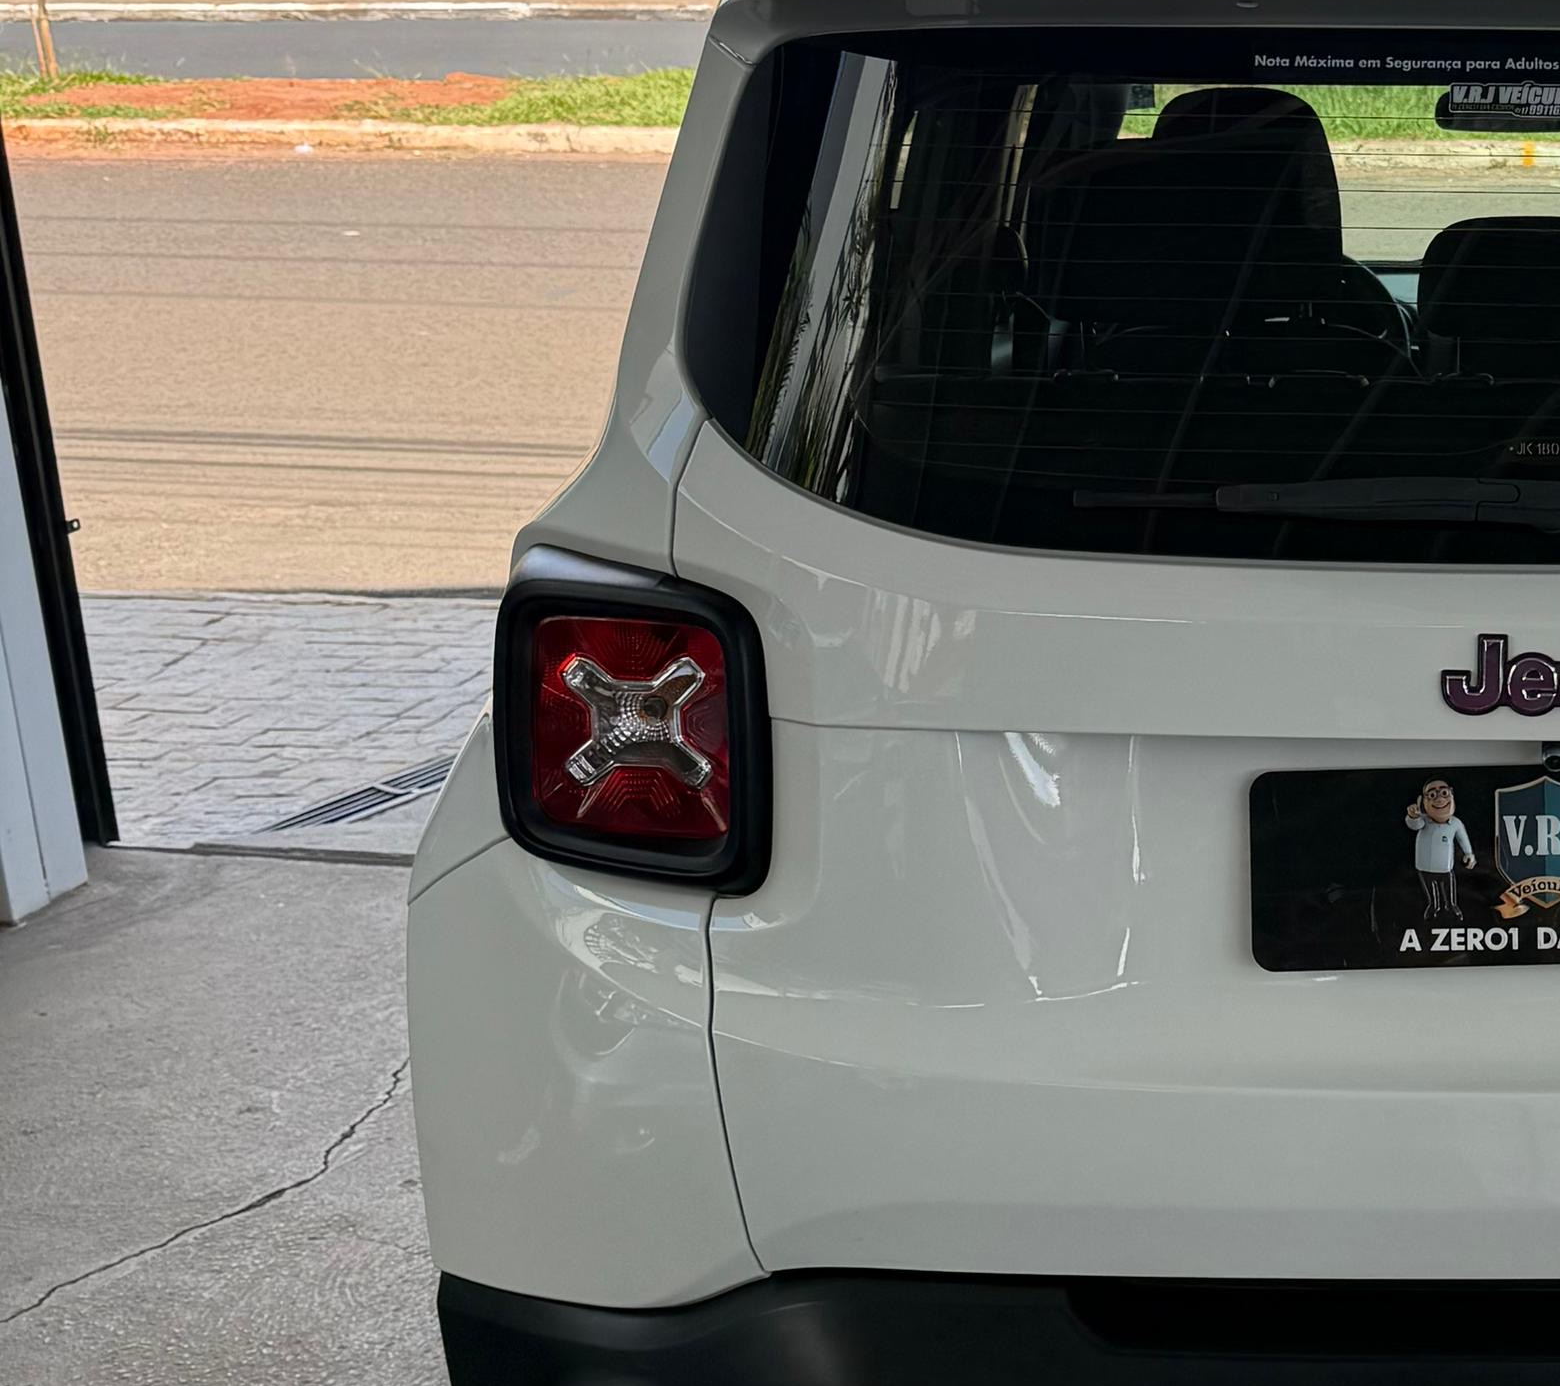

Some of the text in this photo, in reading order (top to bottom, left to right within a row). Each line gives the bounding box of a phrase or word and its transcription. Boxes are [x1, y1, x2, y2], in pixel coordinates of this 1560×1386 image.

[1254, 55, 1290, 67] Nota
[1294, 55, 1354, 68] Máxima
[1358, 58, 1381, 68] em
[1385, 57, 1461, 71] Segurança
[1466, 59, 1500, 72] para
[1505, 57, 1559, 70] Adultos
[1452, 85, 1496, 104] V.R.J
[1400, 929, 1423, 953] A
